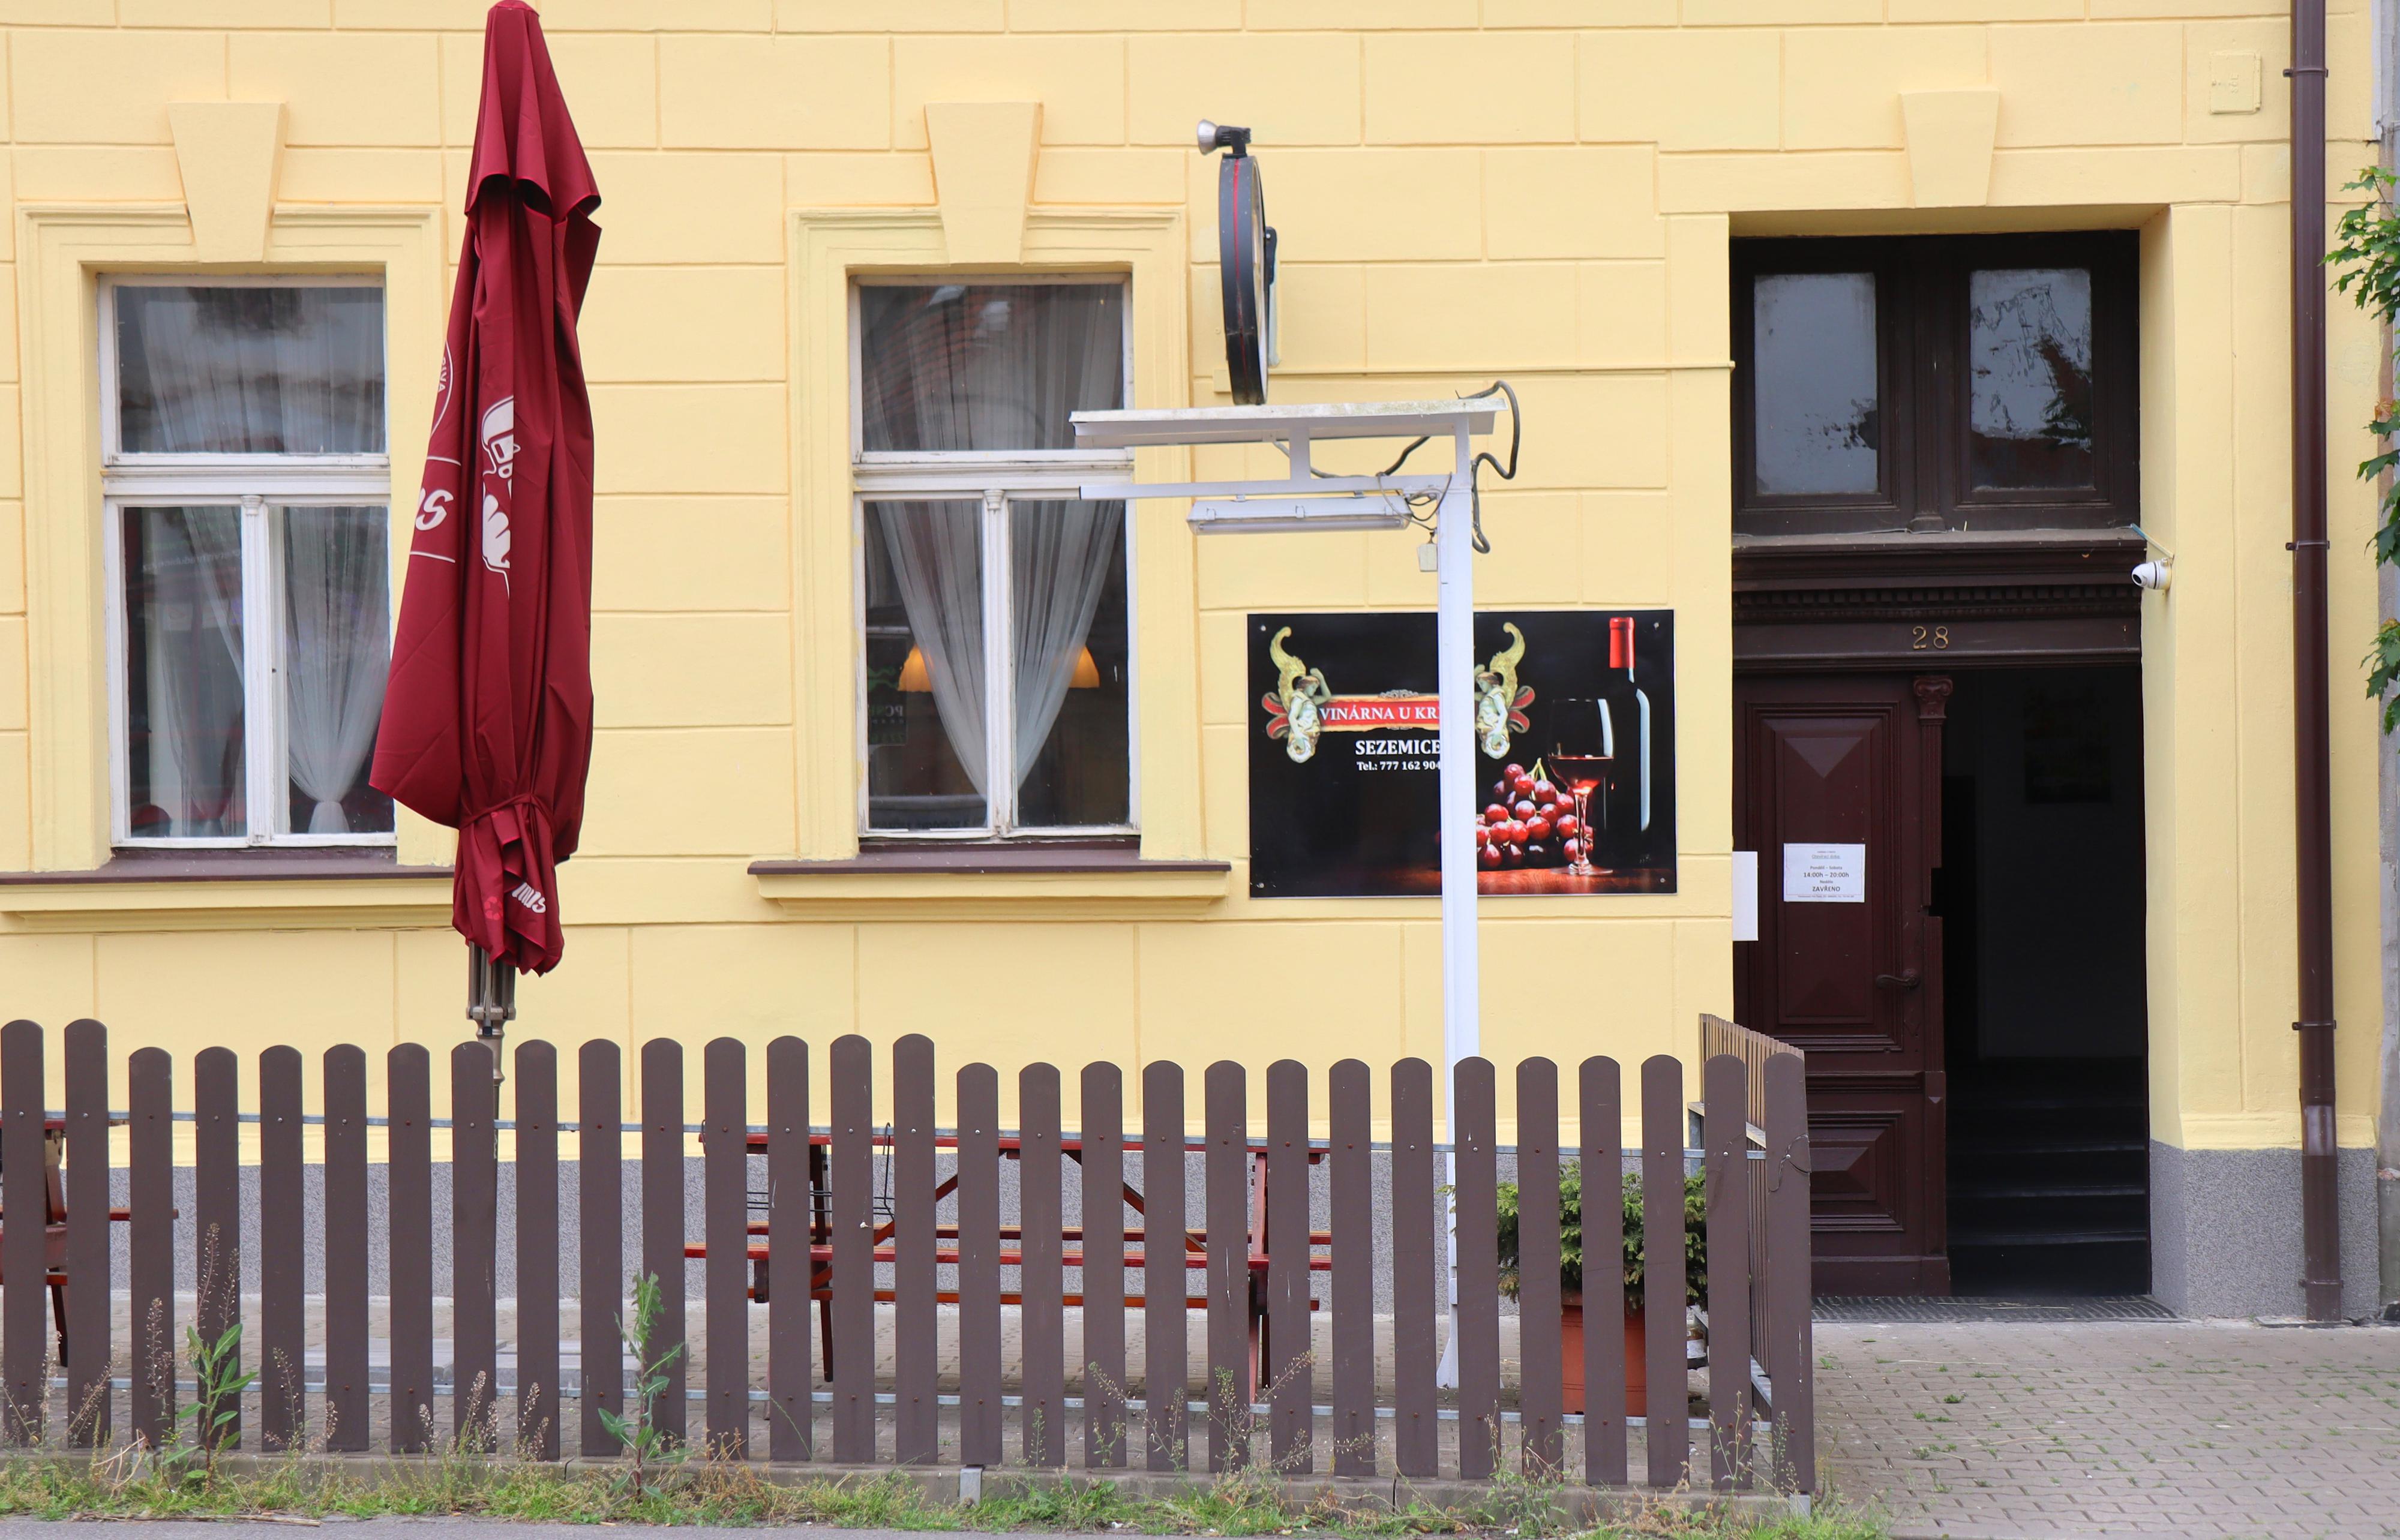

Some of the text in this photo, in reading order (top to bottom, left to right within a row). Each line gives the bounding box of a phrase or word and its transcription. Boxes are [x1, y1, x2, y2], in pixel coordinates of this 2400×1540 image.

[1913, 626, 1948, 649] 28
[1319, 705, 1440, 721] VINÁRNA U KR
[1357, 761, 1378, 771] Tel.:
[1380, 761, 1399, 770] 777
[1402, 761, 1420, 770] 162
